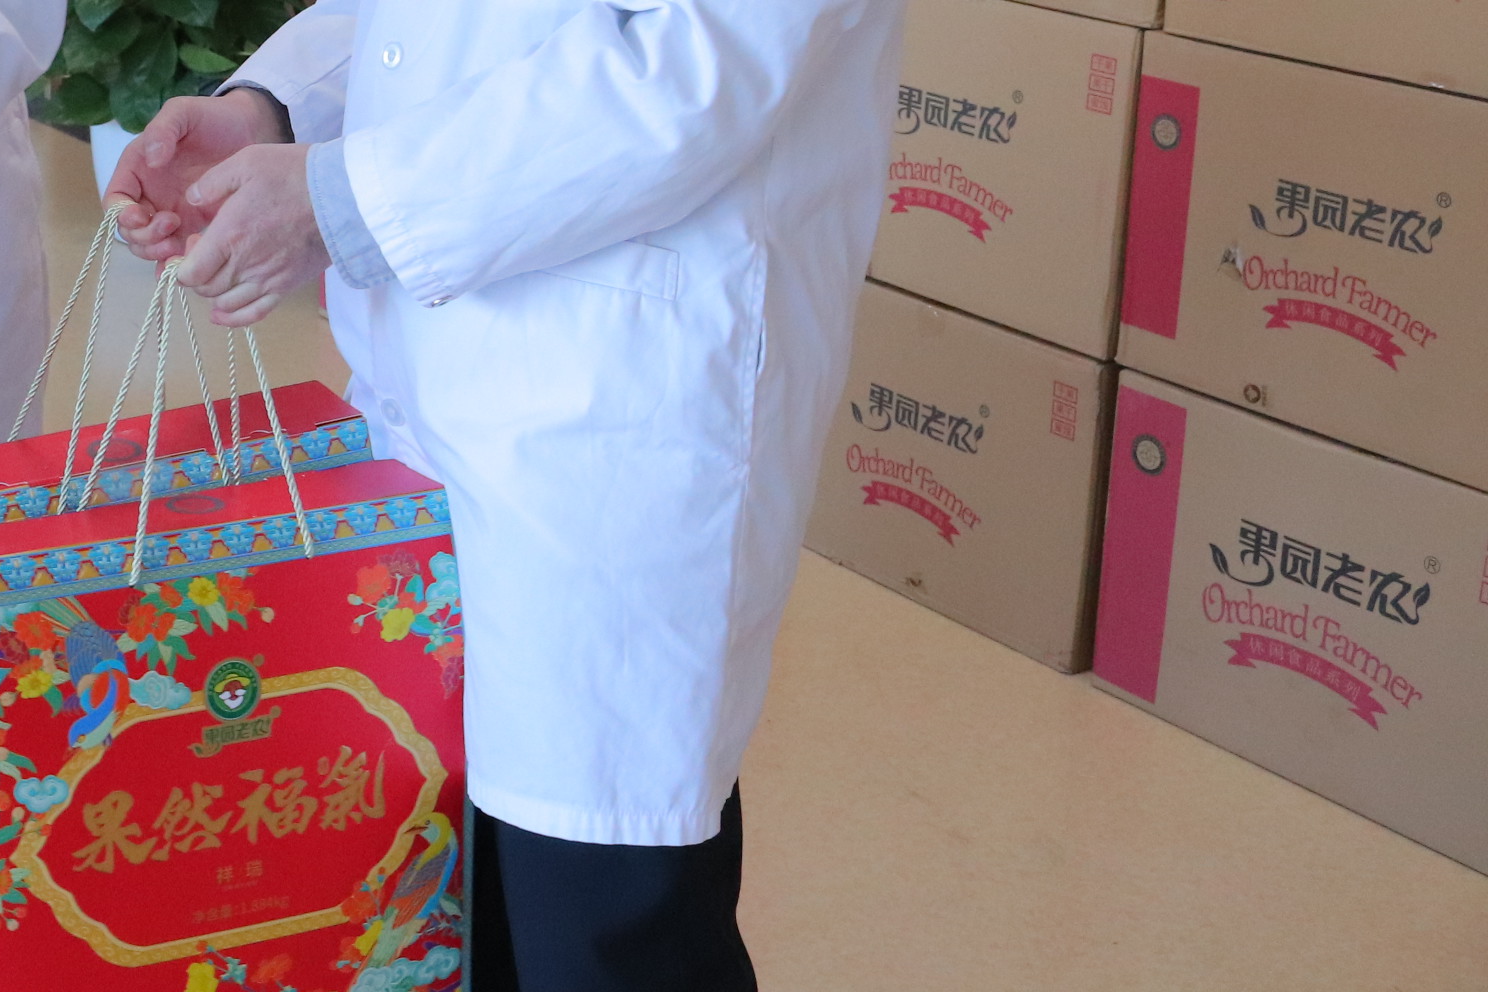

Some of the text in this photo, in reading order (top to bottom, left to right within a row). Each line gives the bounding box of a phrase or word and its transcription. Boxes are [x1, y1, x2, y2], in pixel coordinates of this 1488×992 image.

[895, 85, 1017, 144] 果园老农
[889, 152, 1013, 223] rchard Farmer
[1249, 179, 1443, 254] 果园老农
[1243, 255, 1438, 348] Orchard Farmer
[1285, 302, 1385, 347] 休闲食品系列
[851, 383, 985, 454] 果园老农
[846, 444, 982, 531] Orchard Farmer
[1209, 519, 1430, 625] 果园老农
[1202, 582, 1423, 710] Orchard Farmer
[1248, 636, 1360, 702] 休闲食品系列
